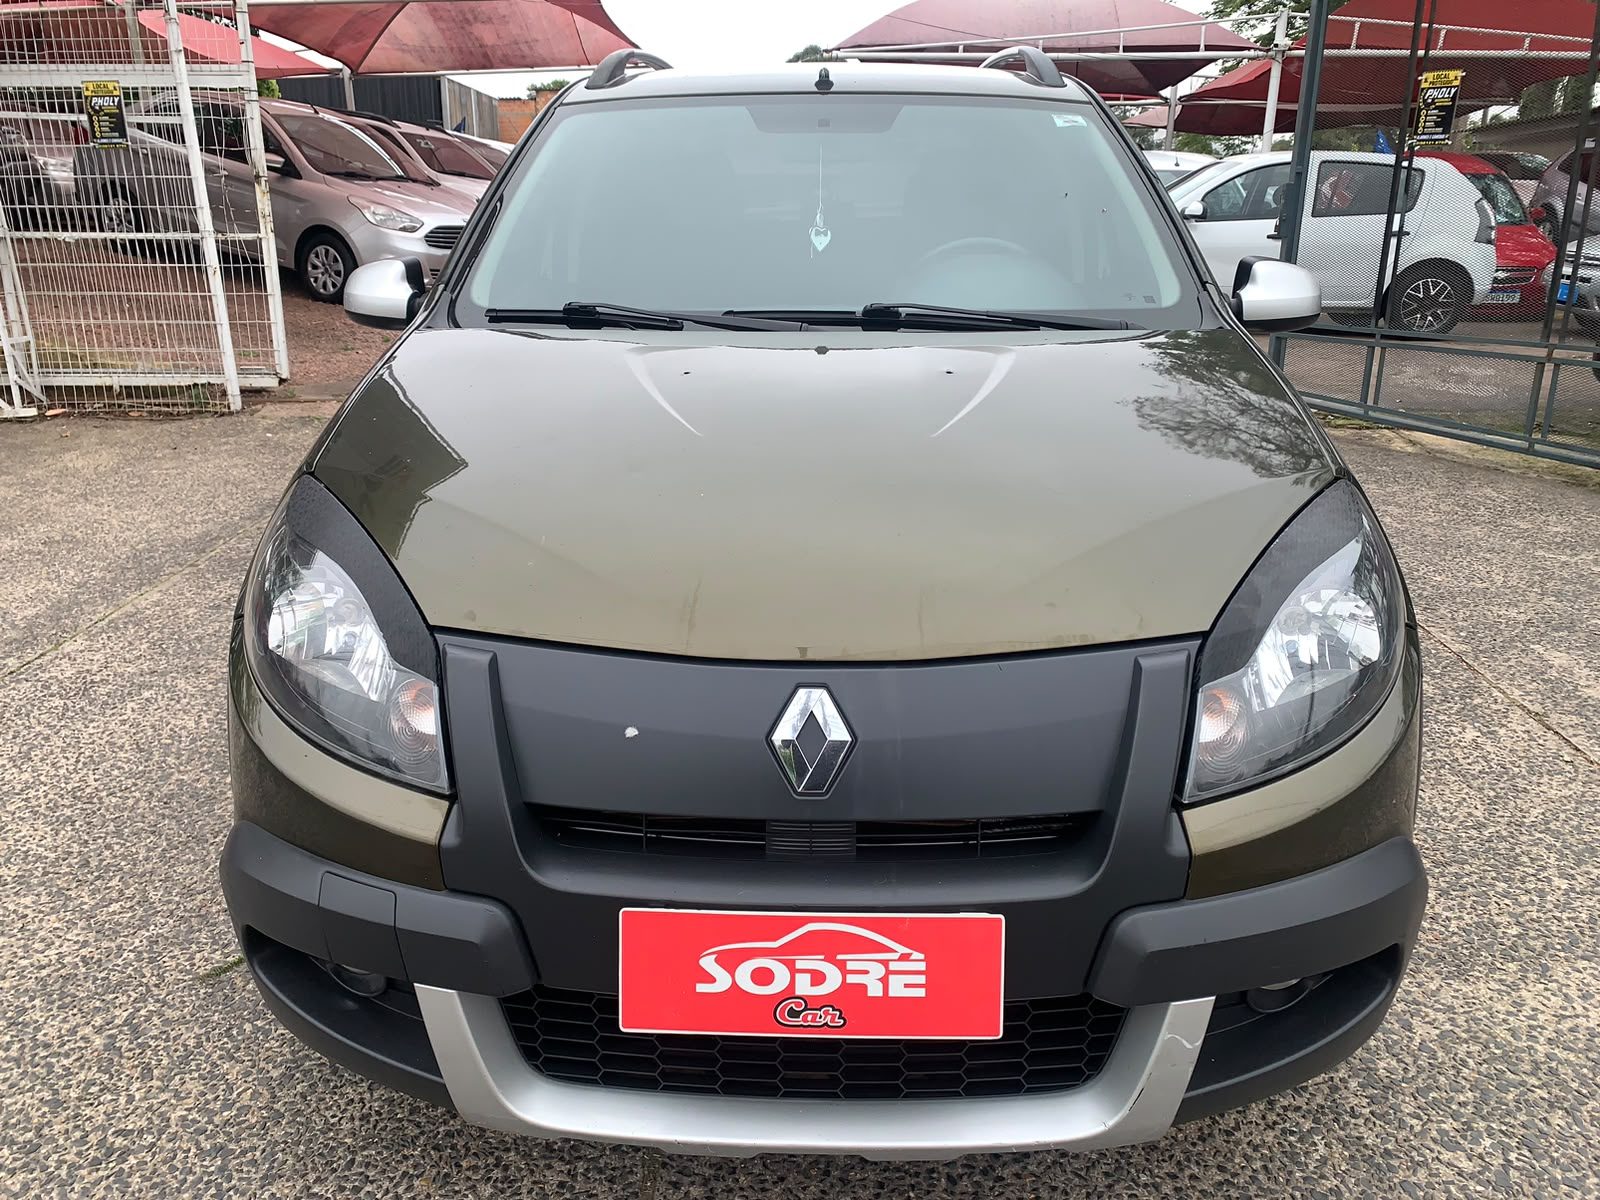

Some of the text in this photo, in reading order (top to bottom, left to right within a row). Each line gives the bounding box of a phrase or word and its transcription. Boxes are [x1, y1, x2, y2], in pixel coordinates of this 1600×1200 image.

[91, 96, 120, 106] PHOLY
[1424, 87, 1458, 99] PHOLY
[695, 952, 926, 998] SODRÉ
[774, 997, 846, 1028] Car
